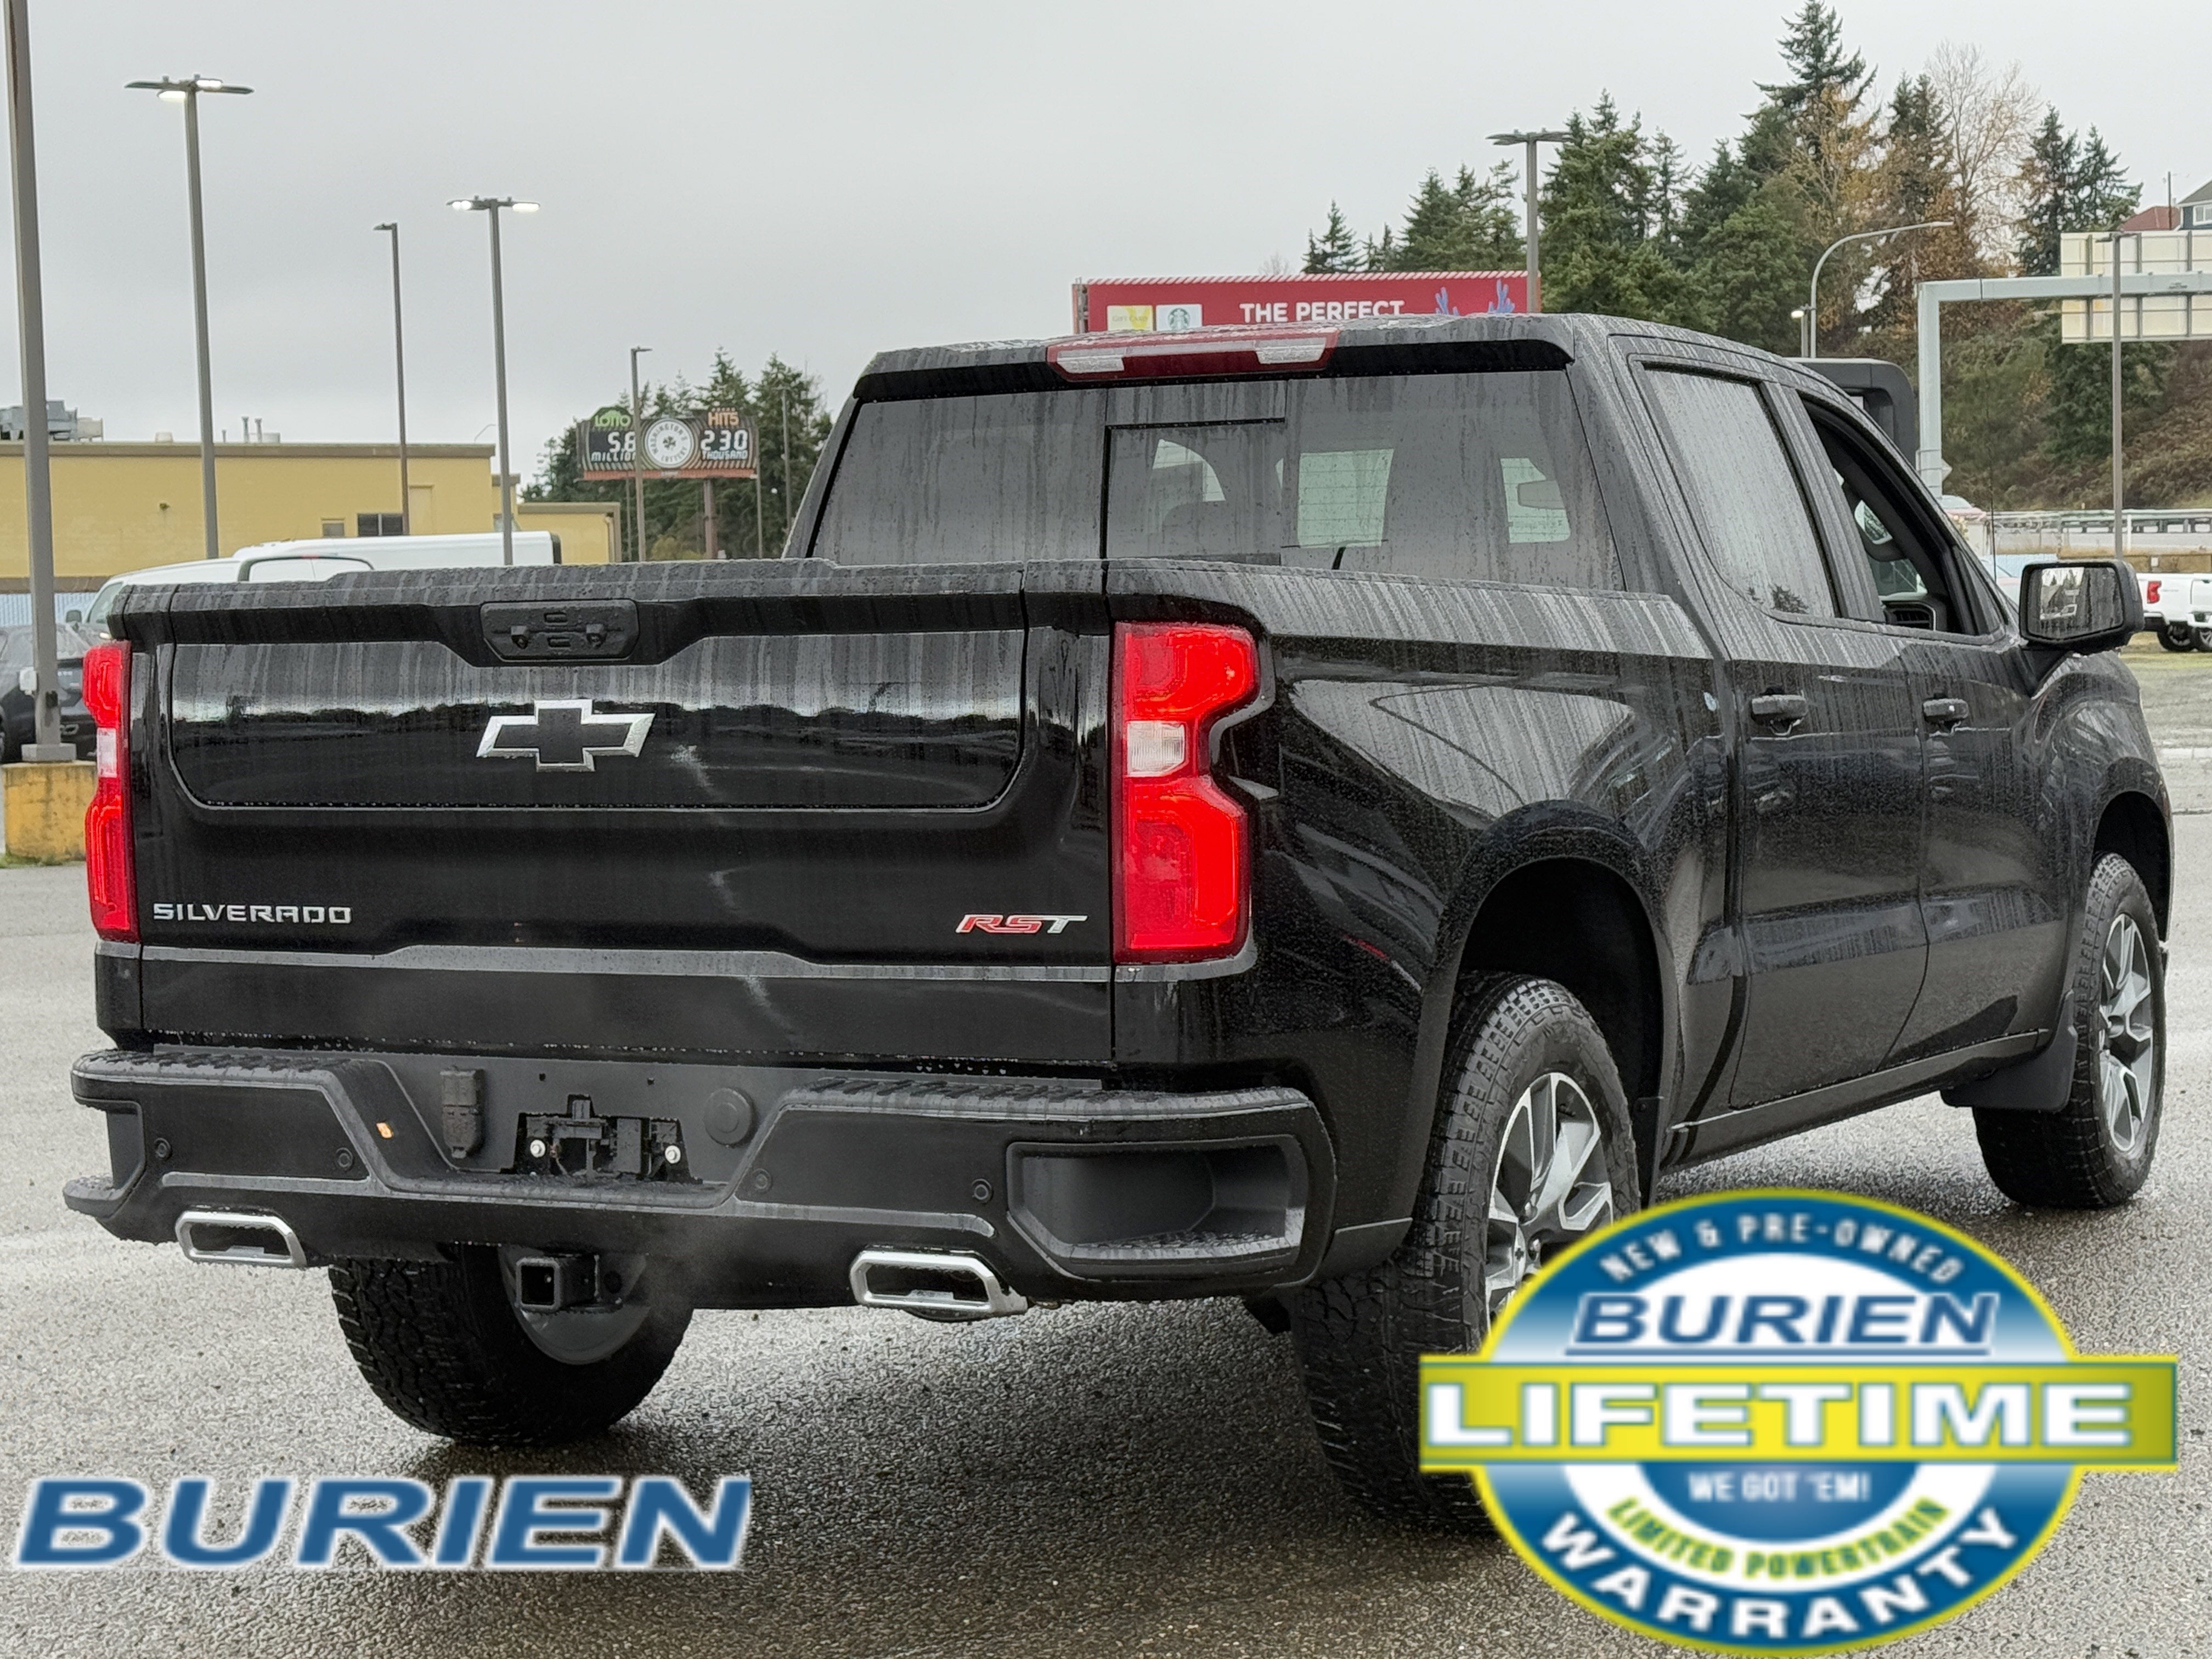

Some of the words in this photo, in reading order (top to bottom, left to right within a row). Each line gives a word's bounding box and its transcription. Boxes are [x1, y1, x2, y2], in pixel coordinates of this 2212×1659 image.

[1239, 302, 1289, 323] THE
[1295, 300, 1406, 321] PERFECT
[595, 412, 631, 427] LOTTO
[701, 430, 748, 451] 230
[153, 903, 352, 924] SILVERADO
[955, 915, 1088, 933] RST
